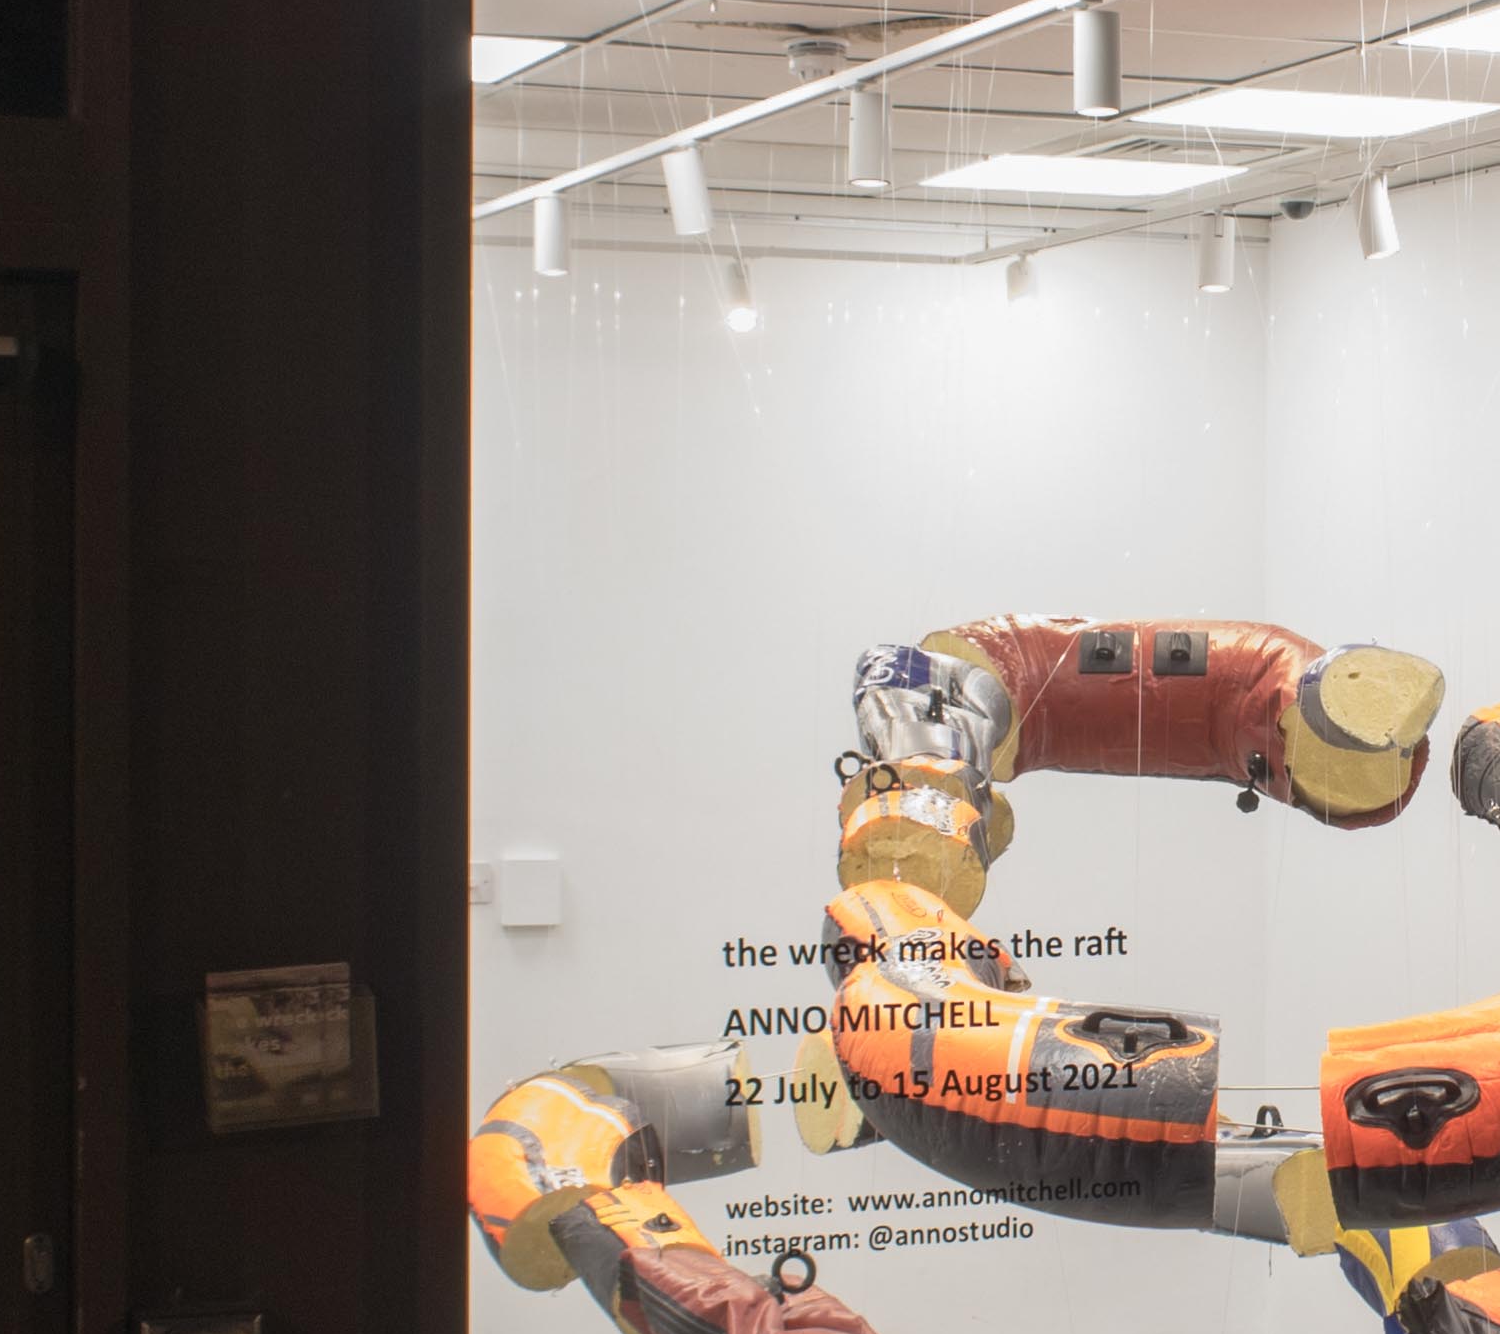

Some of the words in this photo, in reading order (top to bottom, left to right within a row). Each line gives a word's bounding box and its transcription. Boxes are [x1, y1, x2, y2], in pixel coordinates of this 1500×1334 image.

[722, 937, 778, 968] the
[788, 934, 888, 965] wreck
[900, 931, 1001, 962] makes
[1011, 929, 1063, 959] the
[1074, 927, 1128, 957] raft
[723, 1005, 828, 1037] ANNO
[839, 1000, 1000, 1033] MITCHELL
[724, 1077, 764, 1107] 22
[773, 1072, 838, 1110] July
[848, 1074, 883, 1101] to
[893, 1070, 931, 1100] 15
[940, 1067, 1053, 1102] August
[1062, 1061, 1138, 1092] 2021
[725, 1193, 834, 1219] website:
[848, 1178, 1141, 1213] www.annomitchell.com
[726, 1232, 860, 1258] instagram:
[868, 1215, 1034, 1252] @annostudio
